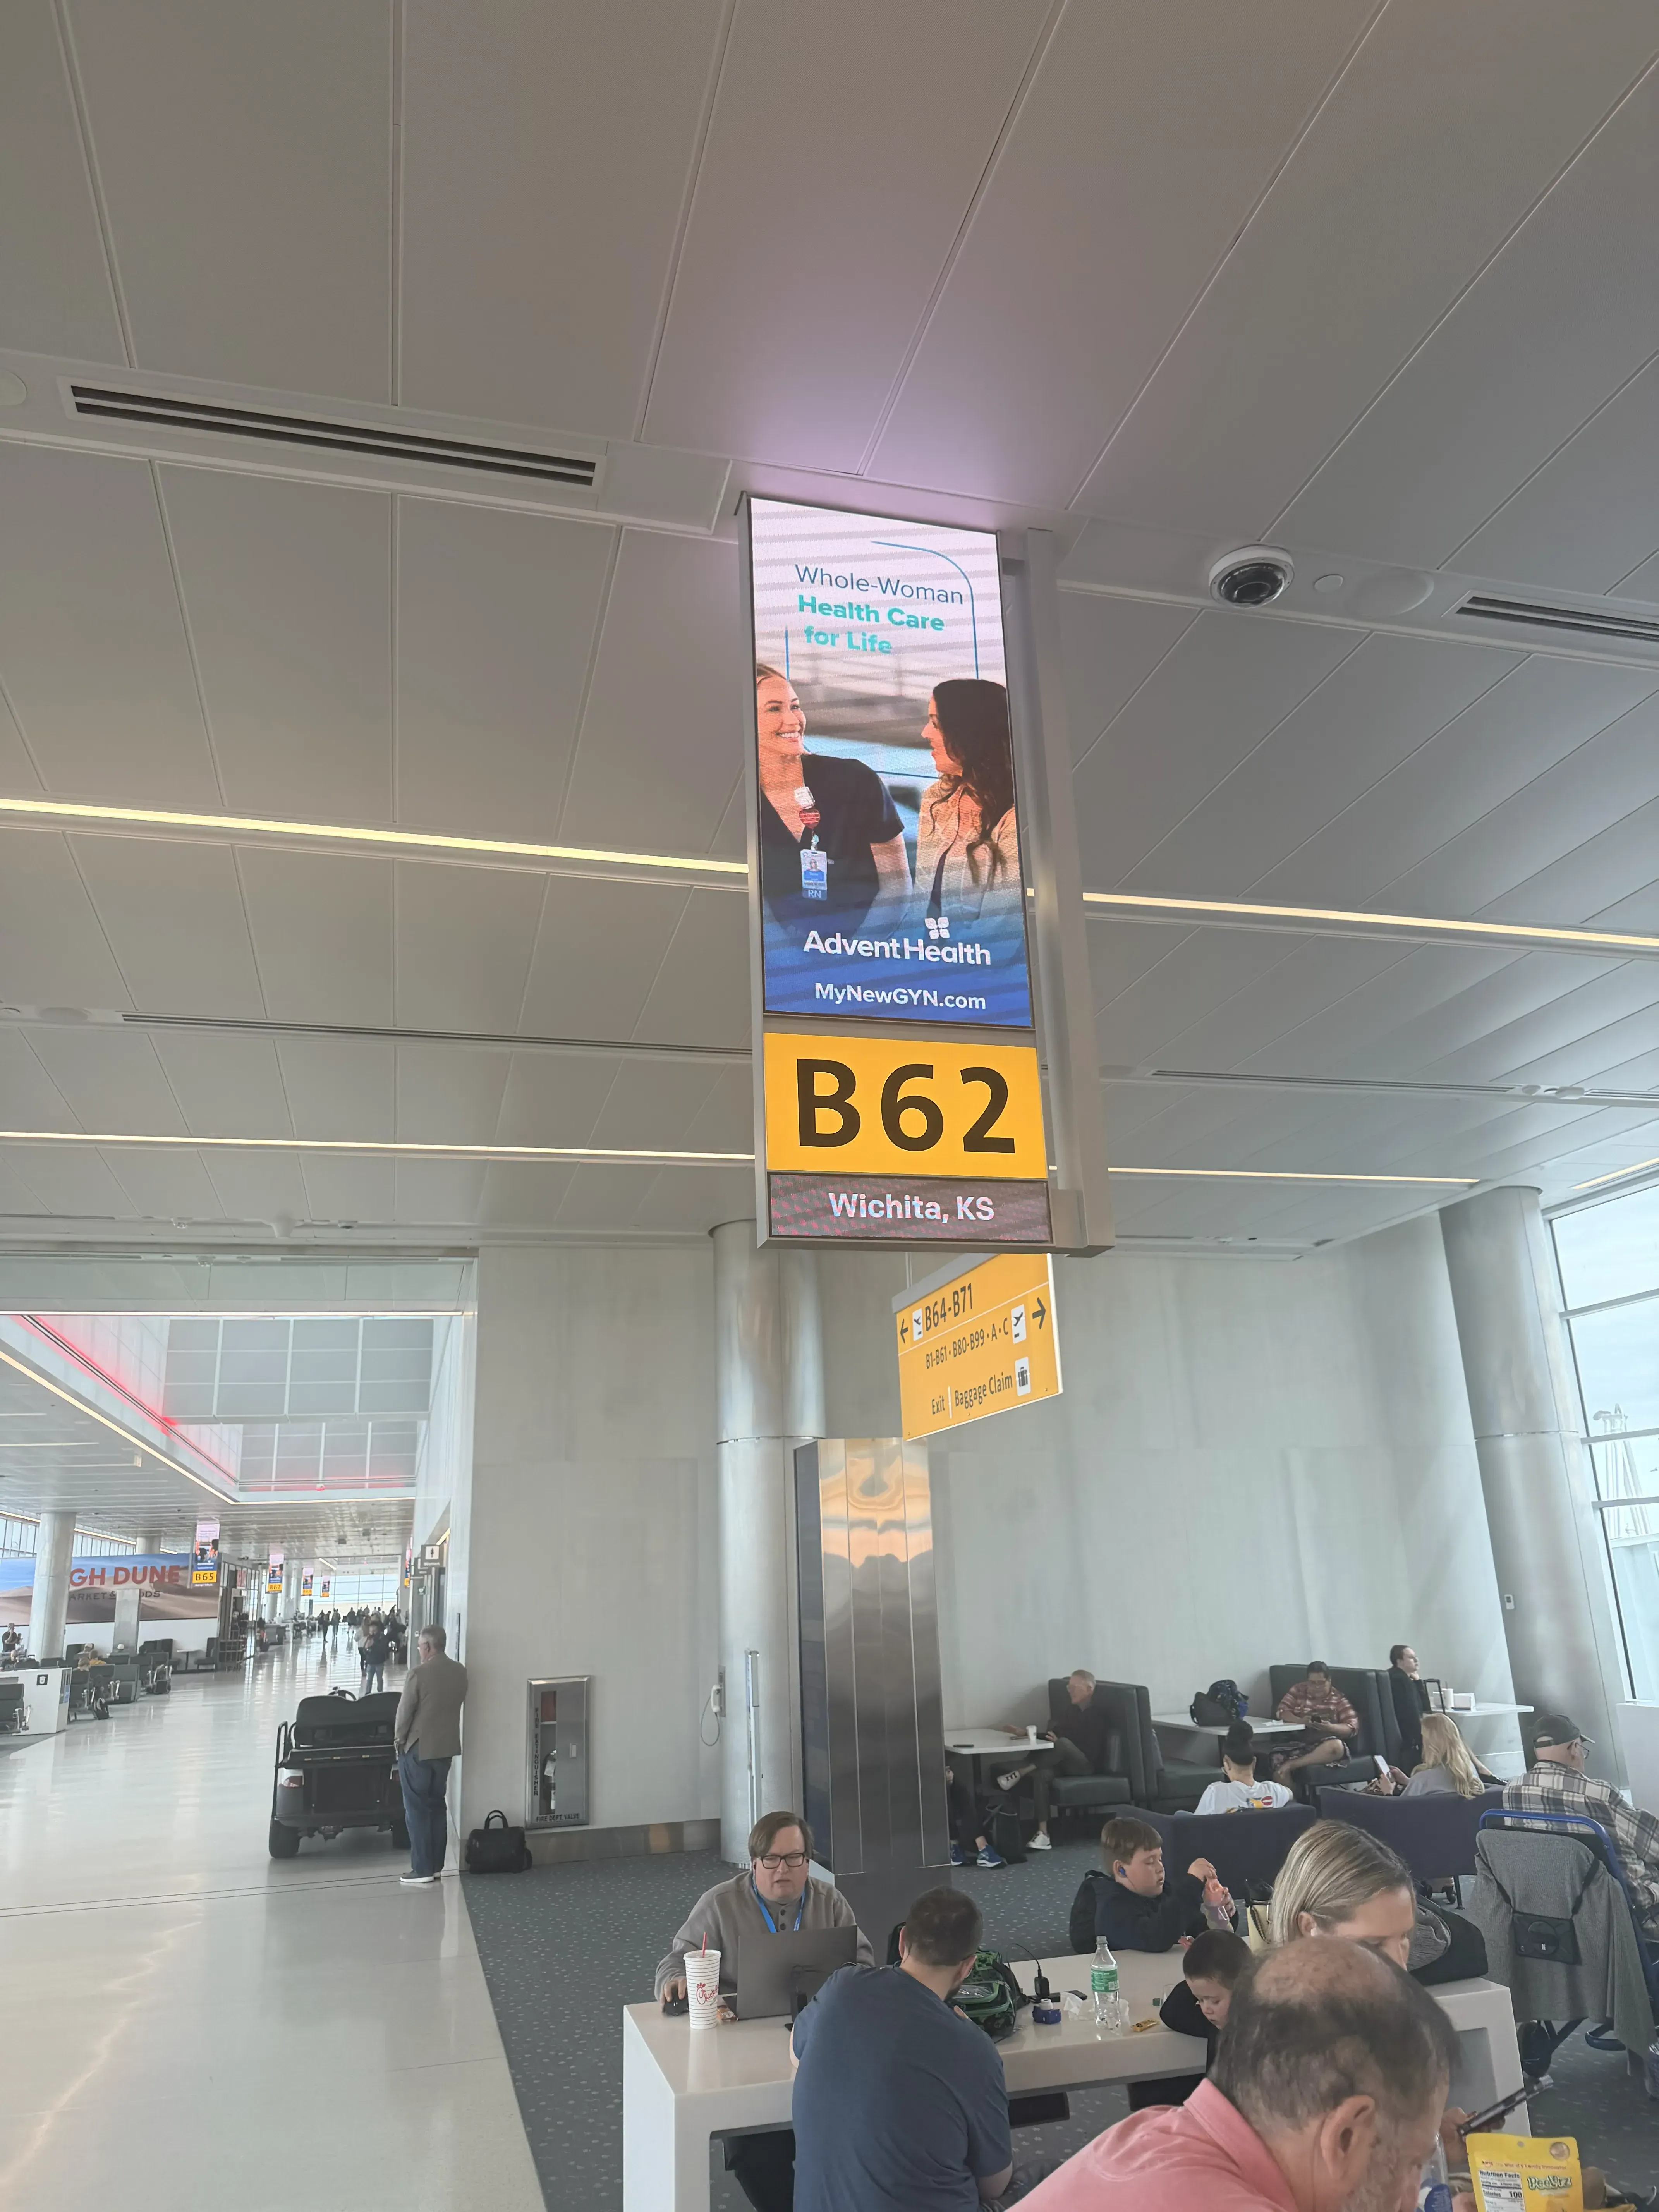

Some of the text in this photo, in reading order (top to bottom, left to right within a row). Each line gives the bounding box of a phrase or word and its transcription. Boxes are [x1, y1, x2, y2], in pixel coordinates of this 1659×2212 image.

[795, 564, 963, 605] Whole-Woman
[798, 594, 945, 631] Health Care
[804, 625, 892, 654] for Life
[808, 890, 821, 898] RN
[803, 931, 991, 965] AdventHealth
[815, 982, 986, 1010] MyNewGYN.com
[797, 1058, 1015, 1153] B62
[828, 1193, 994, 1224] Wichita, KS
[925, 1283, 972, 1331] B64-B71
[991, 1323, 998, 1341] A
[1003, 1317, 1008, 1335] C
[931, 1372, 1013, 1415] Exit Baggage Claim
[69, 1565, 180, 1586] GH DUNE
[195, 1573, 214, 1581] B65
